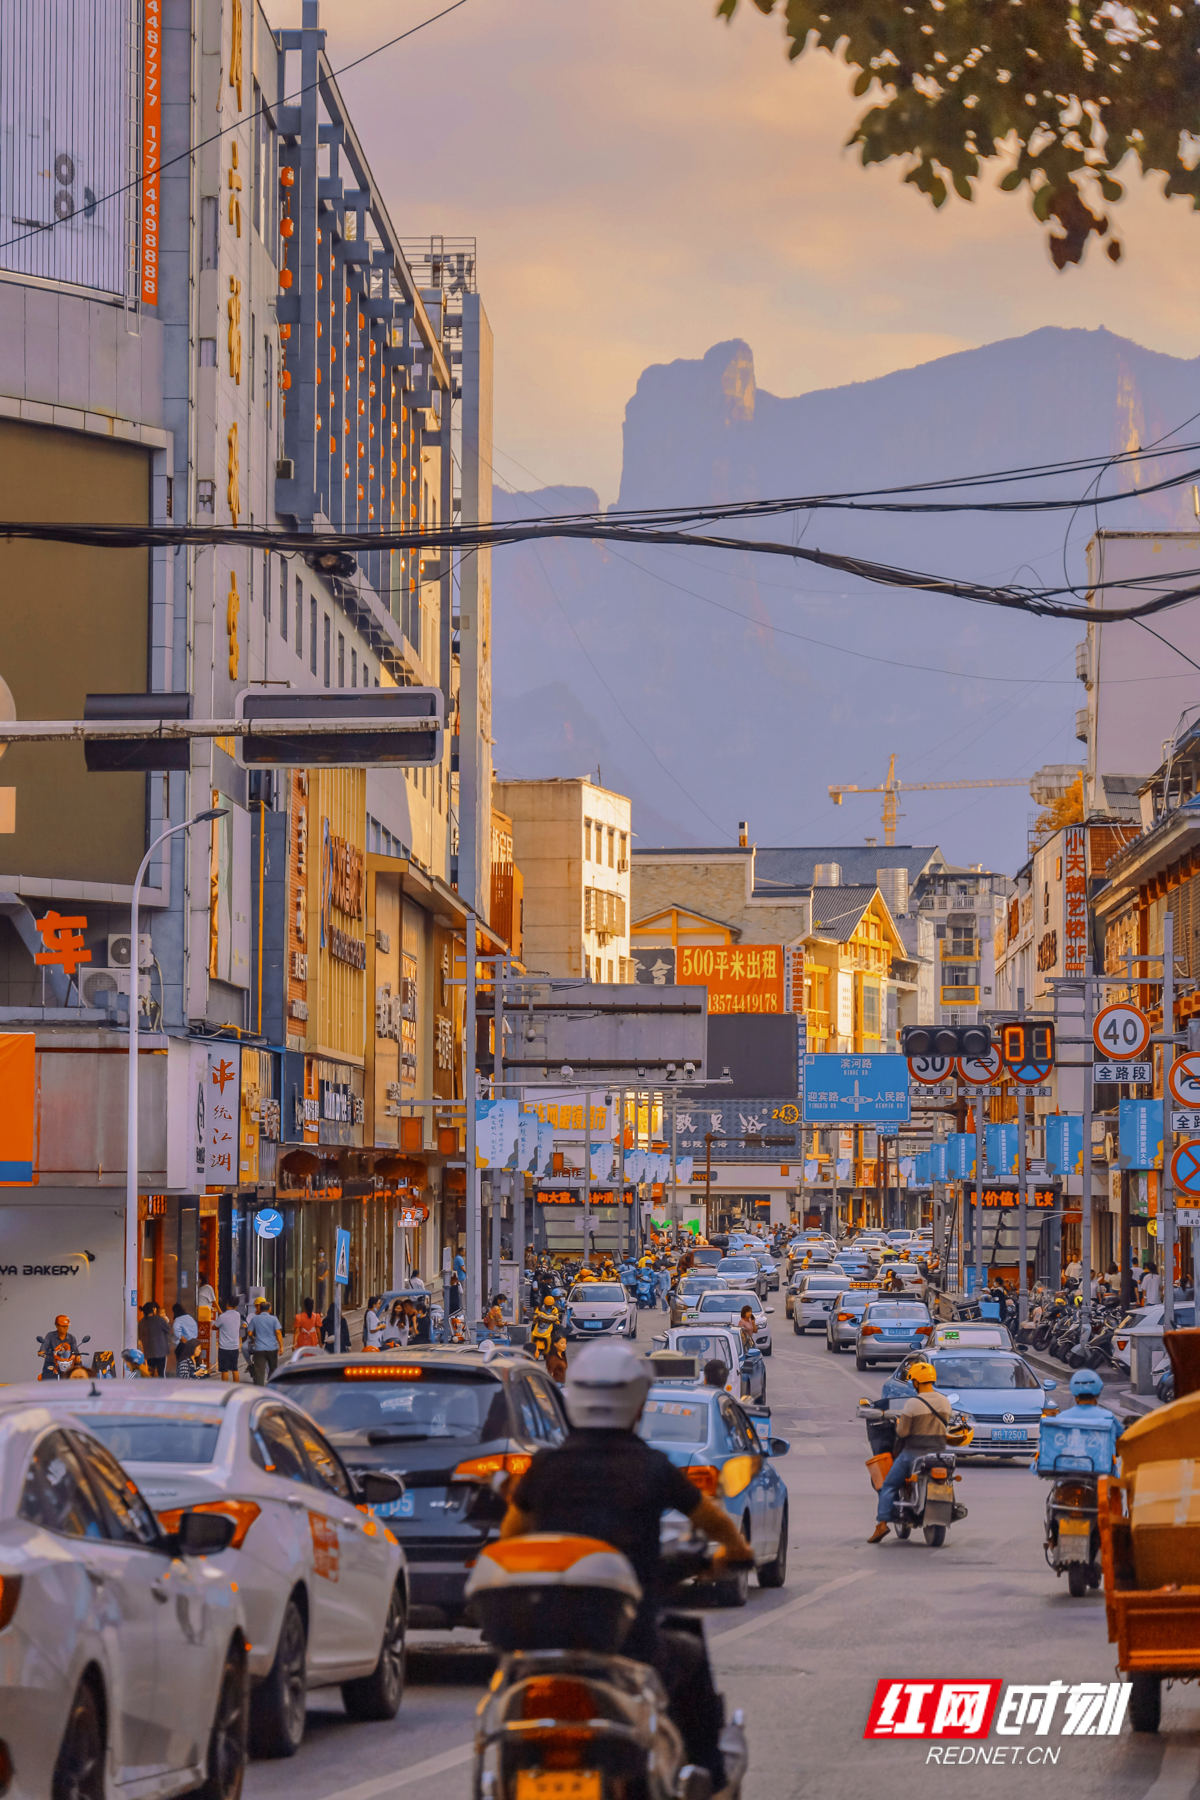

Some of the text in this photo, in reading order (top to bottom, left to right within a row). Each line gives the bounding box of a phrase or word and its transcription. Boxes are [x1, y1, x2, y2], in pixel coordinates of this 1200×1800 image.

[1066, 832, 1086, 939] 小天鹅艺校
[1066, 945, 1086, 958] 3F
[682, 948, 777, 980] 500平米出租
[708, 993, 777, 1012] 13574419178
[1103, 1018, 1137, 1046] 40
[1005, 1027, 1052, 1062] 01
[840, 1058, 872, 1068] 滨河路
[1099, 1066, 1146, 1080] 全路段
[807, 1092, 839, 1102] 迎宾路
[874, 1092, 906, 1102] 人民路
[772, 1108, 786, 1119] 24
[22, 1265, 80, 1276] BAKERY
